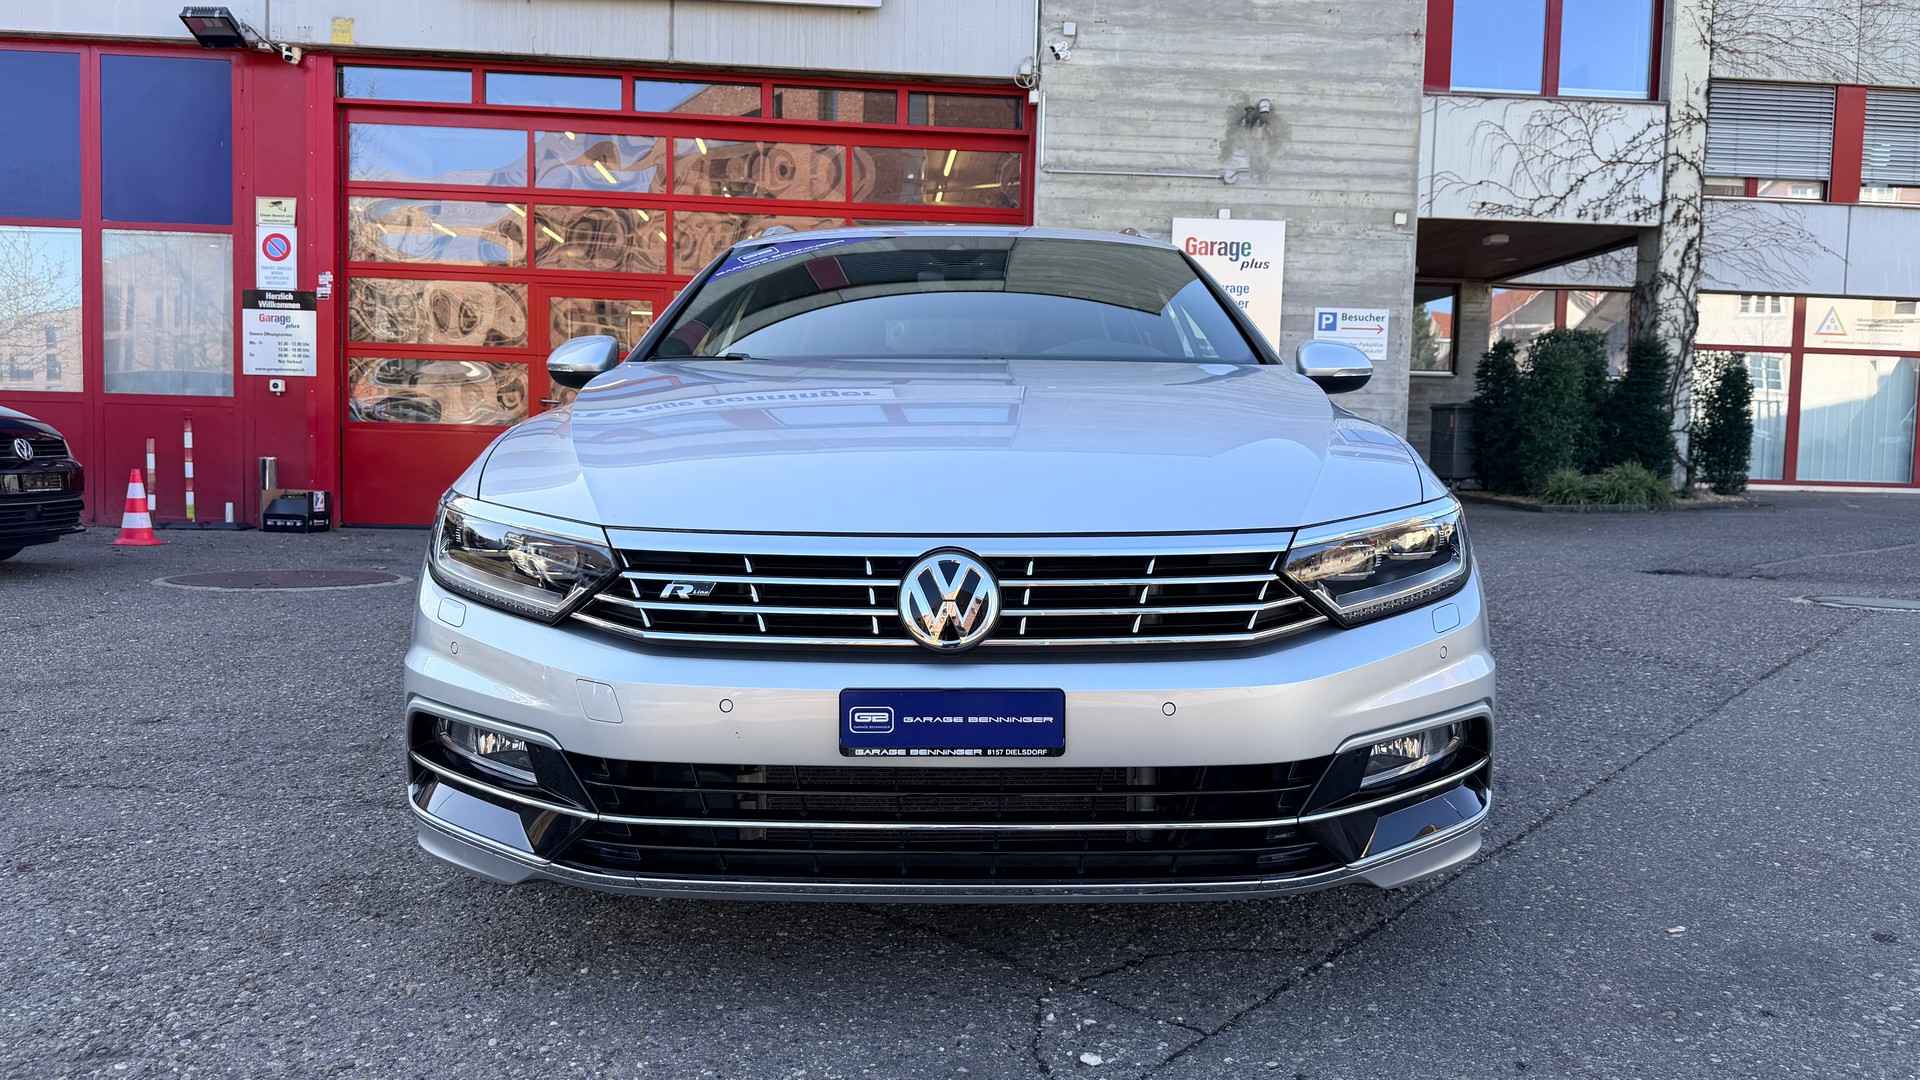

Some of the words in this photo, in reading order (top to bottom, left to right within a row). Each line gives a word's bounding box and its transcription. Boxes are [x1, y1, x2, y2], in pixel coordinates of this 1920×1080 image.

[1185, 236, 1252, 262] Garage
[1240, 258, 1270, 271] plus
[266, 292, 294, 300] Herzlich
[258, 300, 301, 309] Willkommen
[259, 313, 291, 325] Garage
[1321, 314, 1334, 329] P
[1341, 312, 1385, 322] Besucher
[660, 584, 690, 599] R
